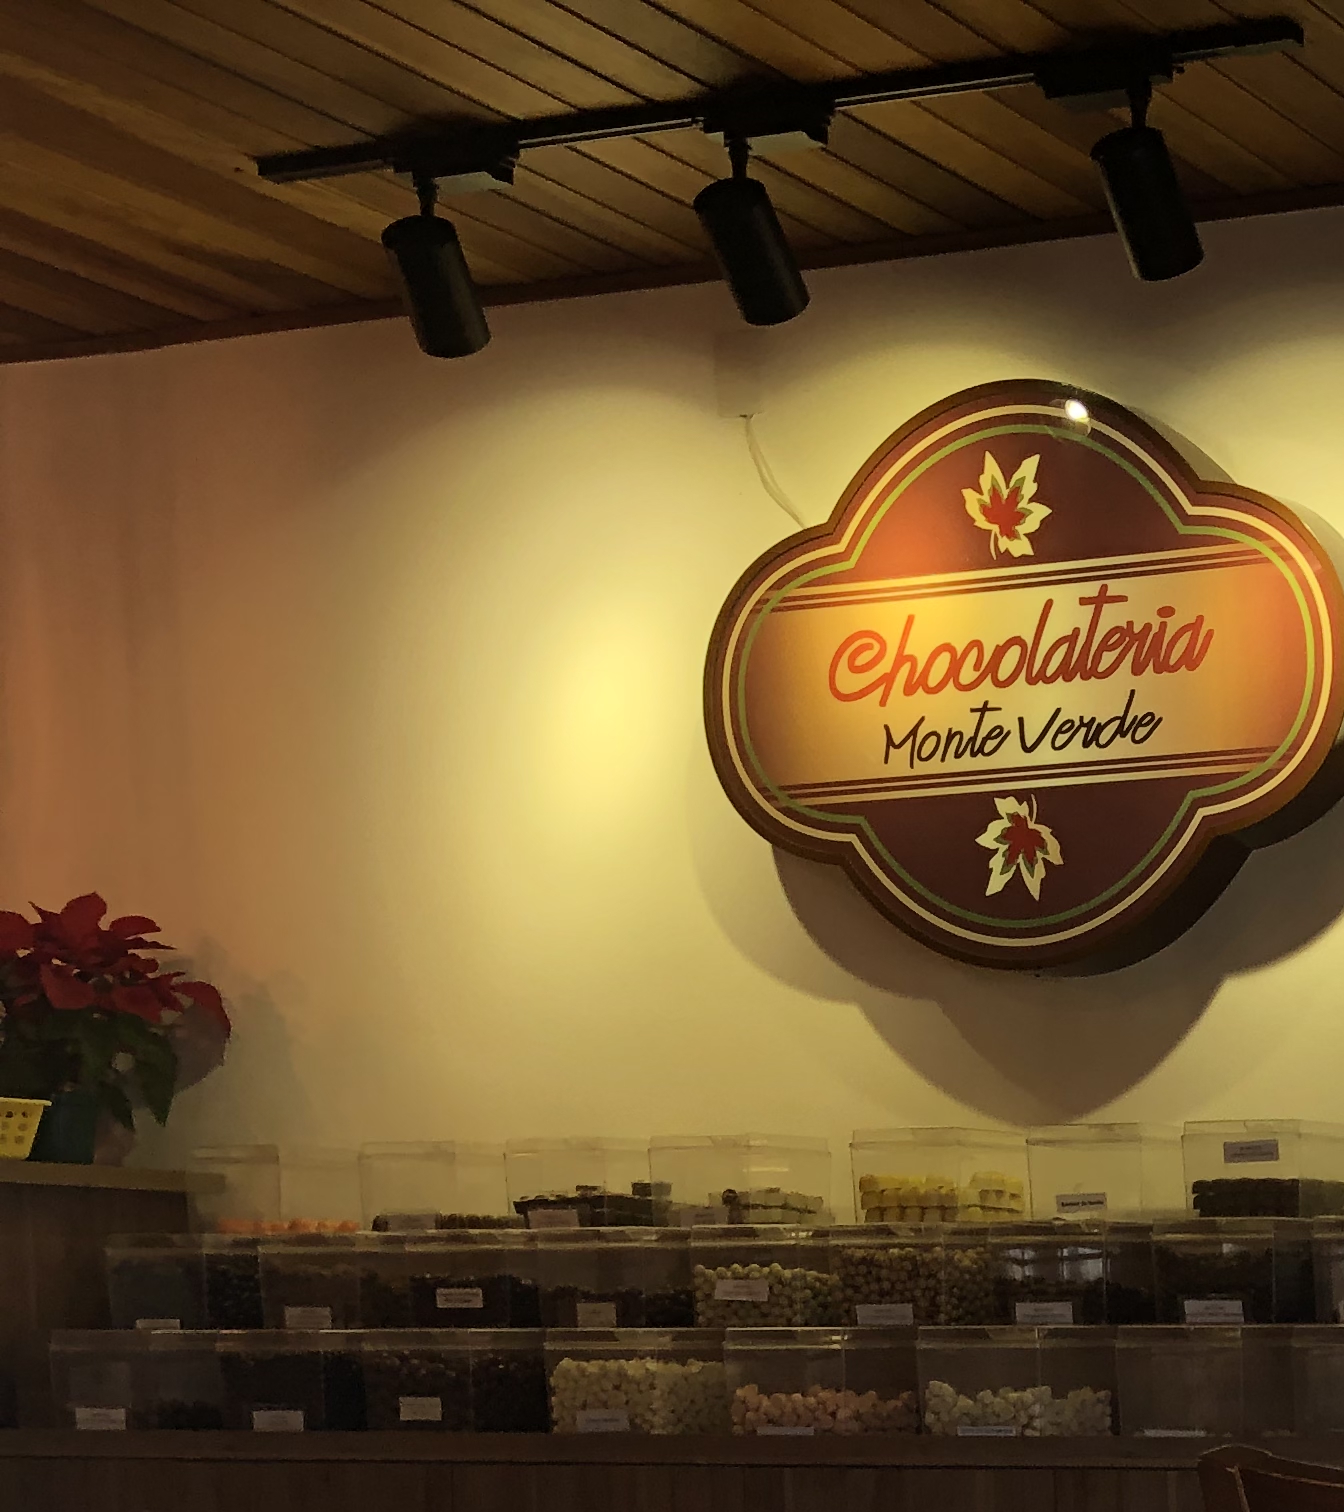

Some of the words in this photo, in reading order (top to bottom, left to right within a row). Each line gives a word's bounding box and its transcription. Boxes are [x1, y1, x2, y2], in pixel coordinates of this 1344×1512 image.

[828, 584, 1214, 707] Chocolateria
[884, 701, 1011, 768] Monte
[1017, 690, 1163, 756] Verde
